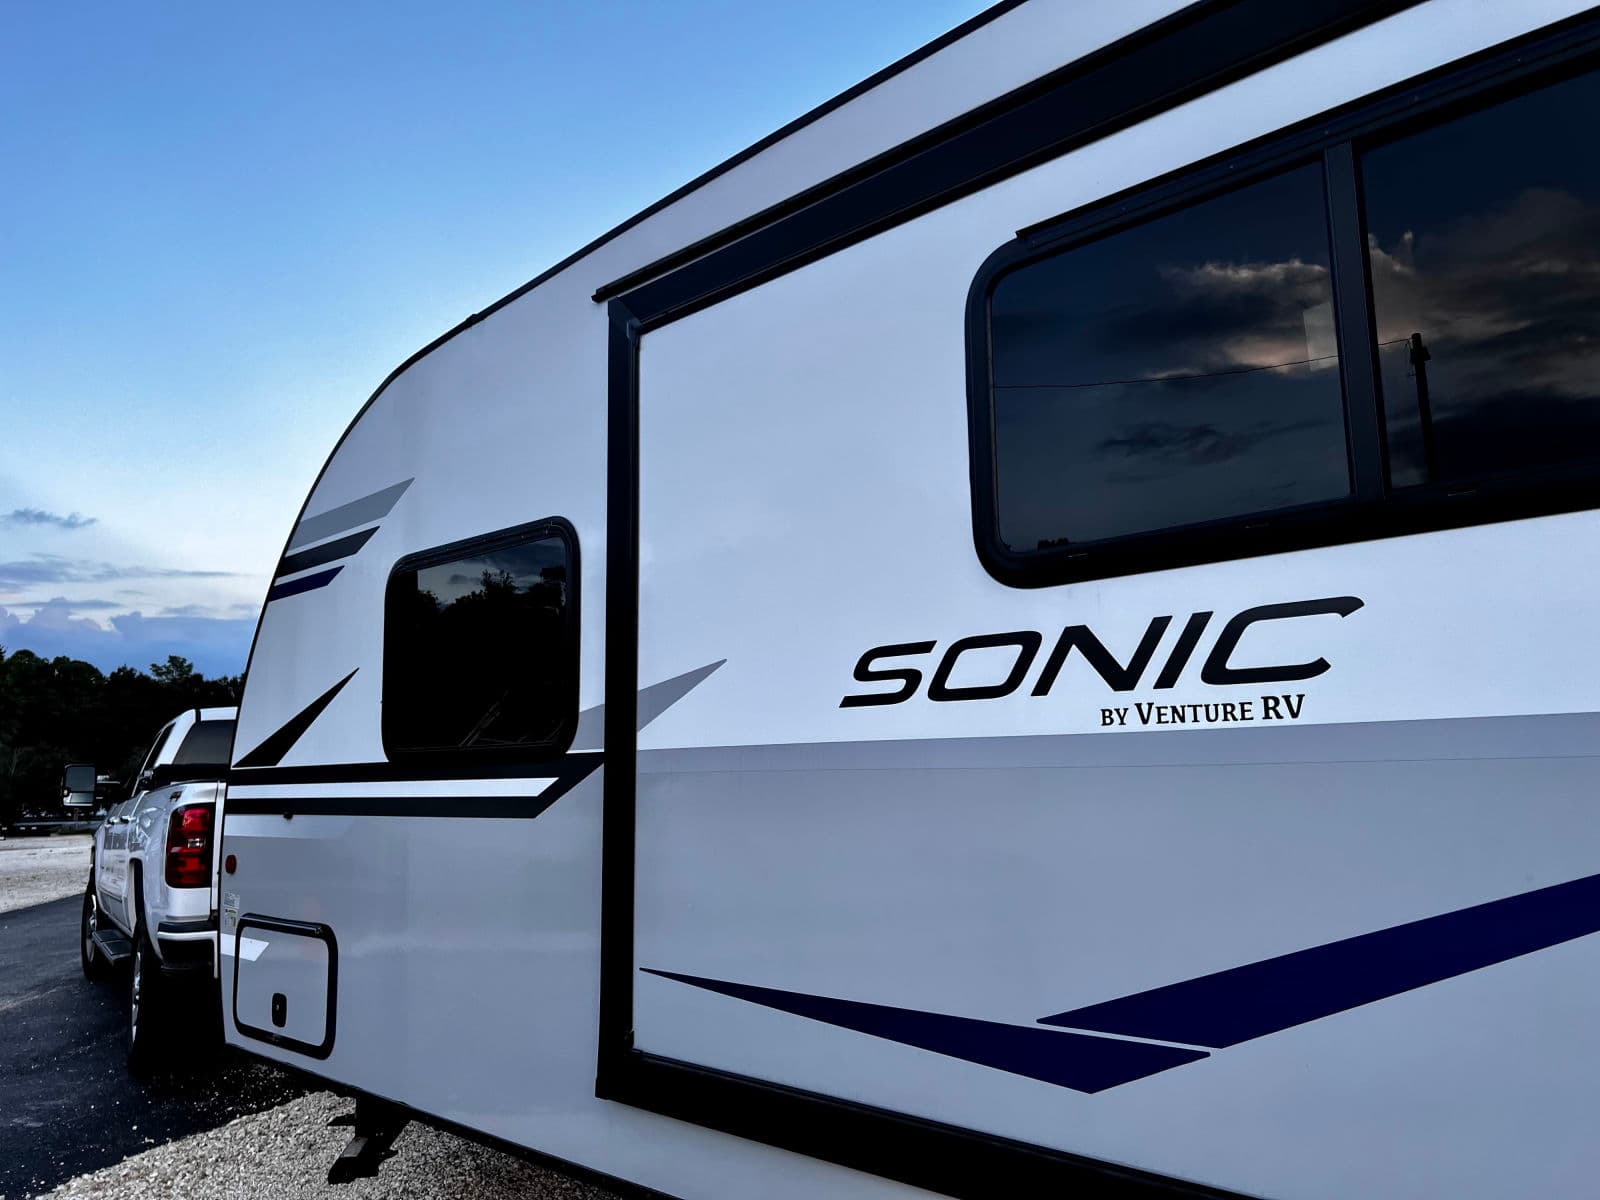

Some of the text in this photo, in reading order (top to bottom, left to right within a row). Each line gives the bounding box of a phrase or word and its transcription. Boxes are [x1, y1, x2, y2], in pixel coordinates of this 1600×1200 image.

[839, 596, 1365, 709] SONIC
[1100, 693, 1306, 727] BY VENTURE RV
